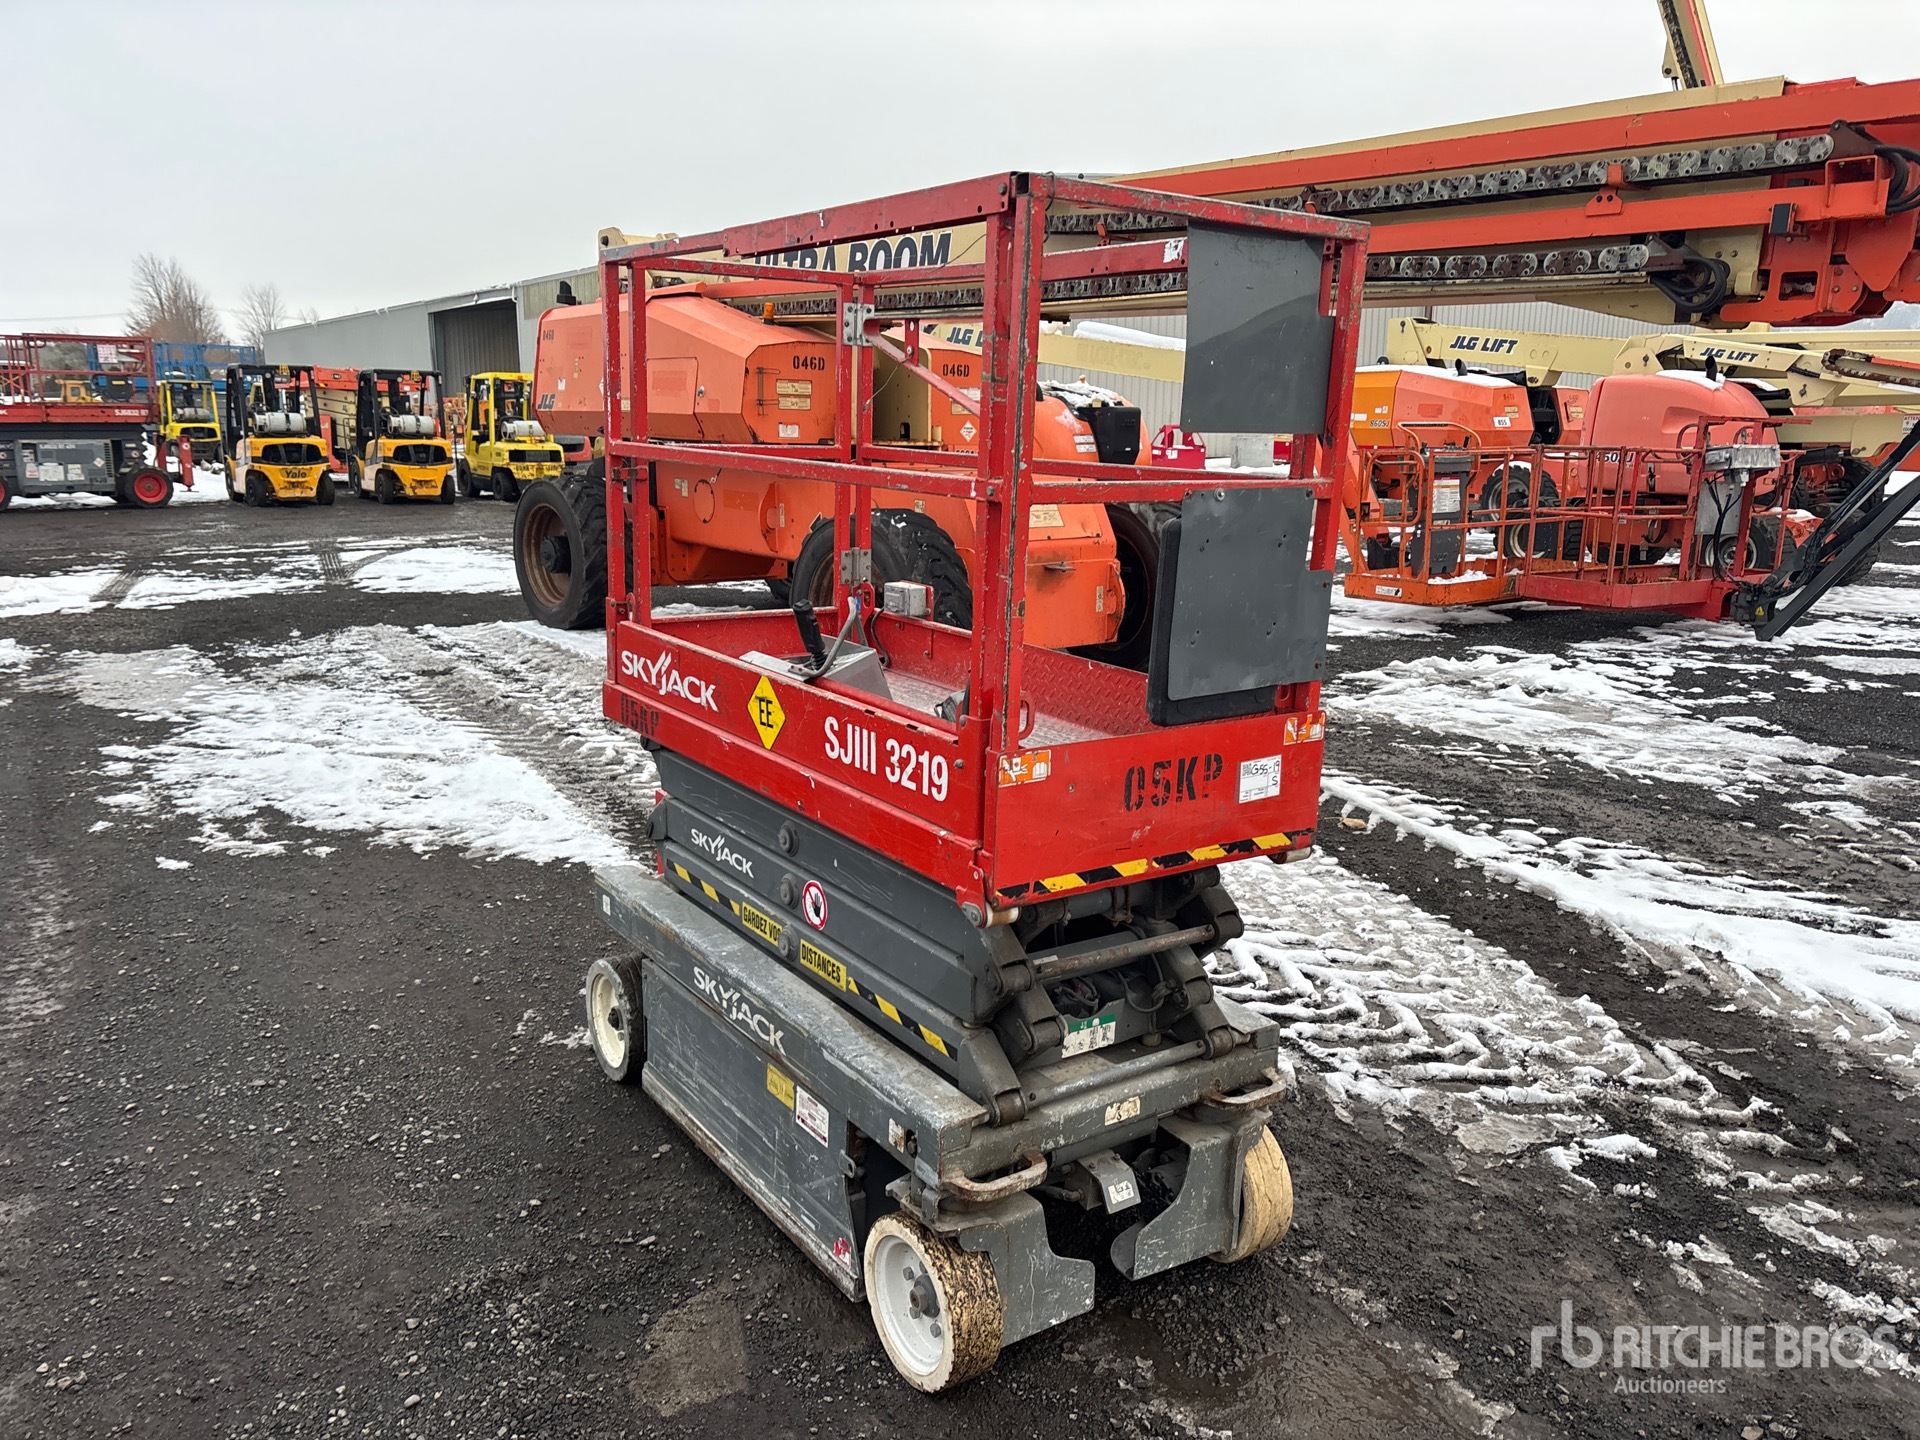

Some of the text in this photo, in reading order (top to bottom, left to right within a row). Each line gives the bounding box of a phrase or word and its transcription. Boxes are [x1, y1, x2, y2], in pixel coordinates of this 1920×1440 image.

[848, 232, 953, 273] BOOM
[946, 327, 973, 346] JLG
[1450, 335, 1519, 354] JLG LIFT
[792, 355, 826, 371] 046D
[1700, 346, 1760, 363] JLG LIFT
[942, 363, 970, 378] 046D
[537, 393, 556, 410] JLG
[621, 650, 720, 713] SKYJACK
[757, 698, 774, 729] EE
[824, 716, 949, 802] SJIII 3219
[690, 828, 755, 879] SKYJACK
[743, 905, 768, 936] GARDEZ
[801, 943, 841, 983] DISTANCES
[693, 966, 787, 1057] SKYJACK
